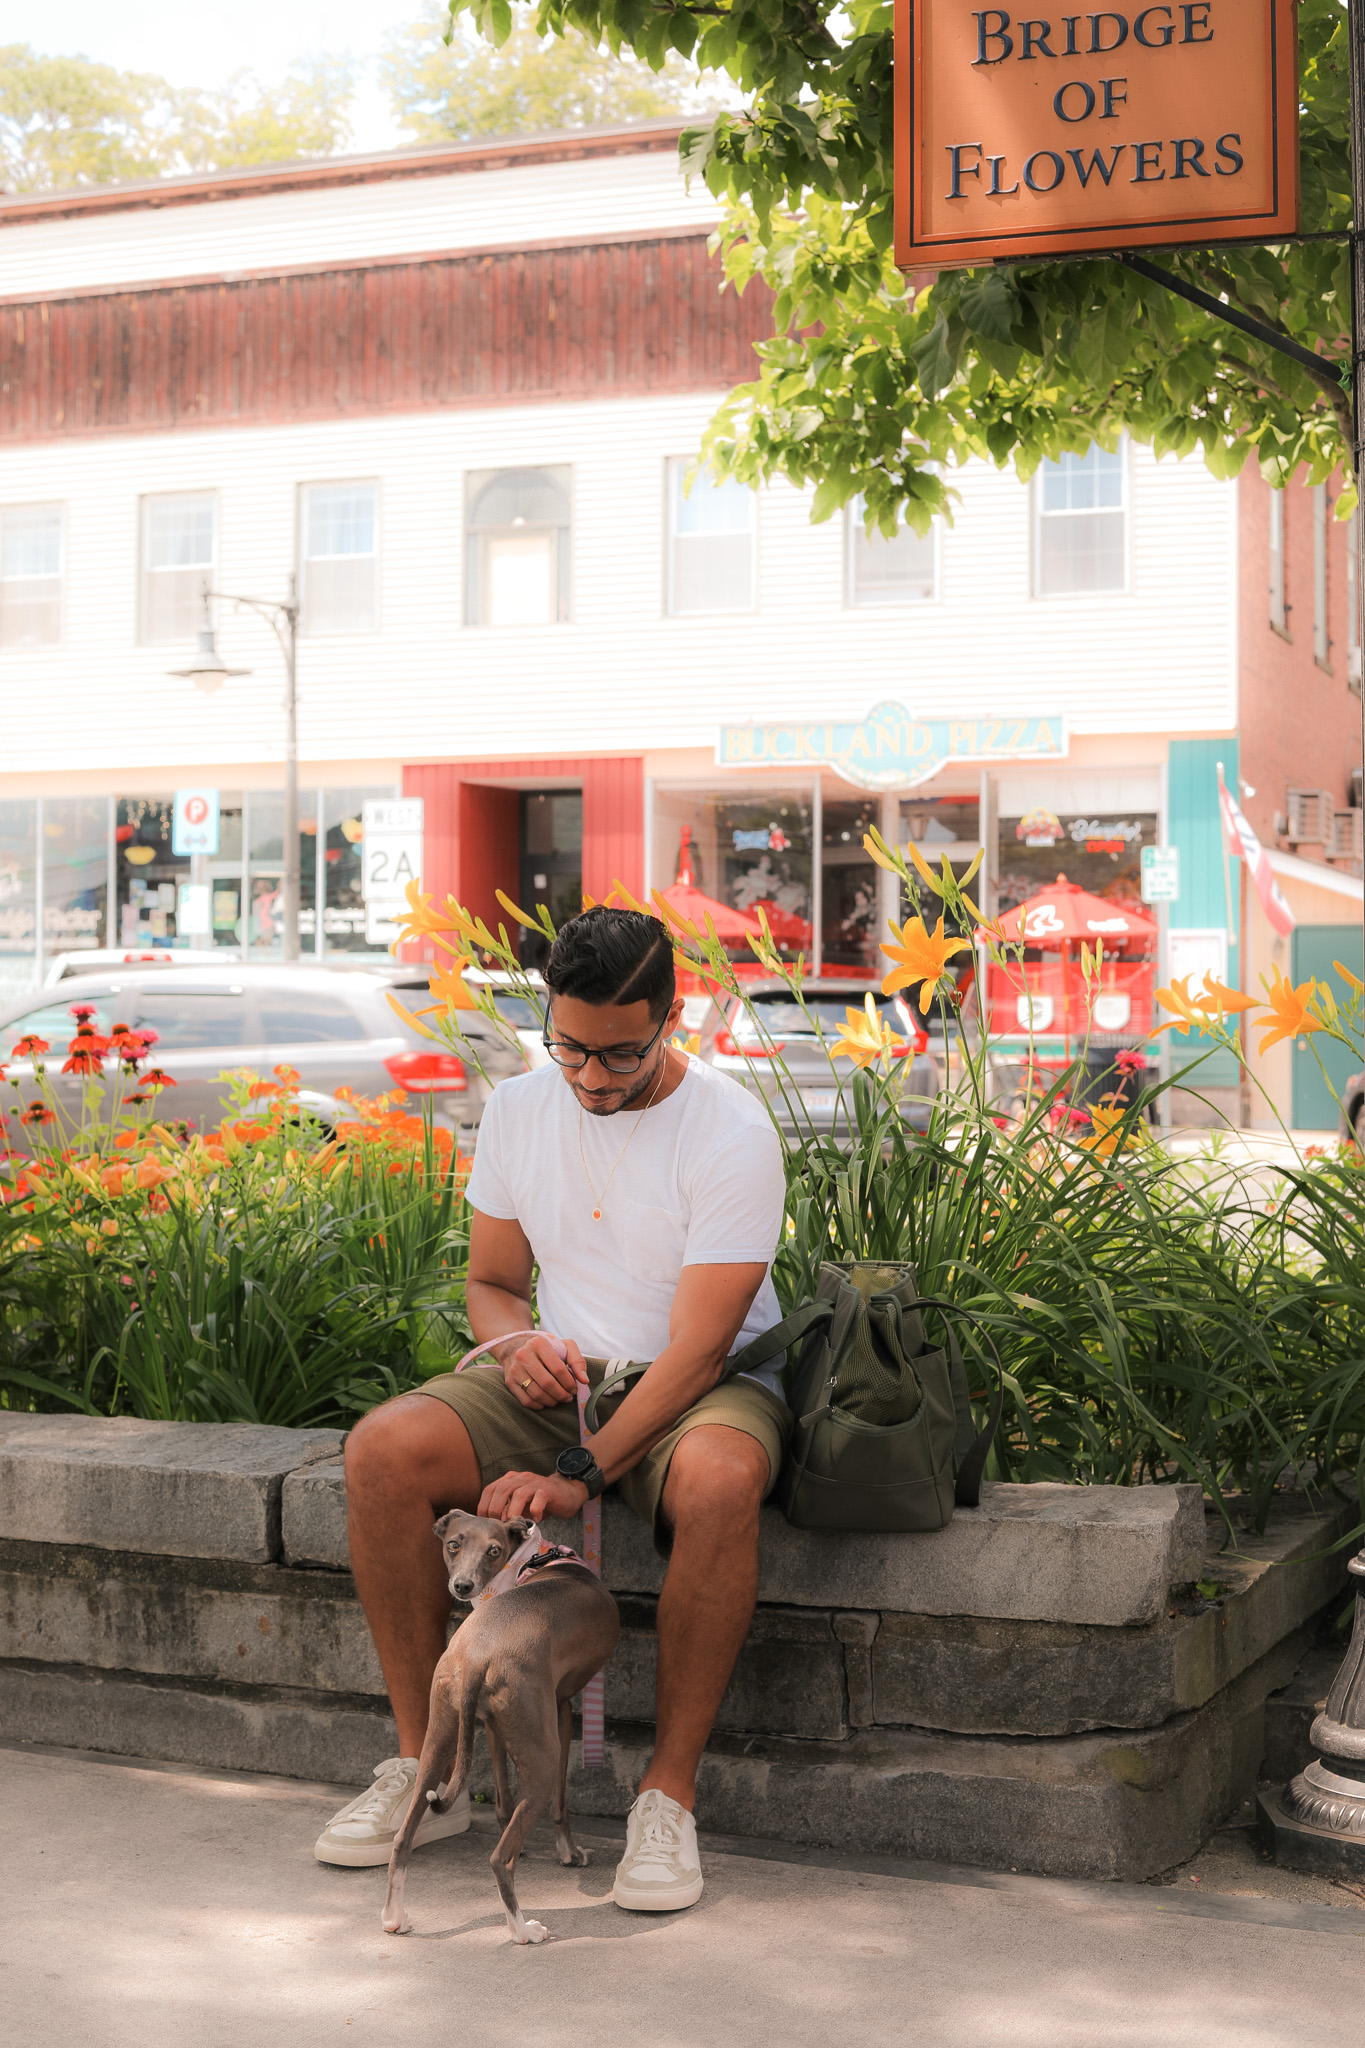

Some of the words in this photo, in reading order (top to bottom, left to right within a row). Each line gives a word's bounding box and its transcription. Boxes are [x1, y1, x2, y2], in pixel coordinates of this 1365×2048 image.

[970, 3, 1214, 65] BRIDGE
[1053, 78, 1128, 122] OF
[944, 133, 1244, 200] FLOWERS
[726, 722, 932, 761] BUCKLAND
[949, 719, 1057, 754] PIZZA
[373, 808, 412, 825] WEST
[370, 850, 415, 883] 2A
